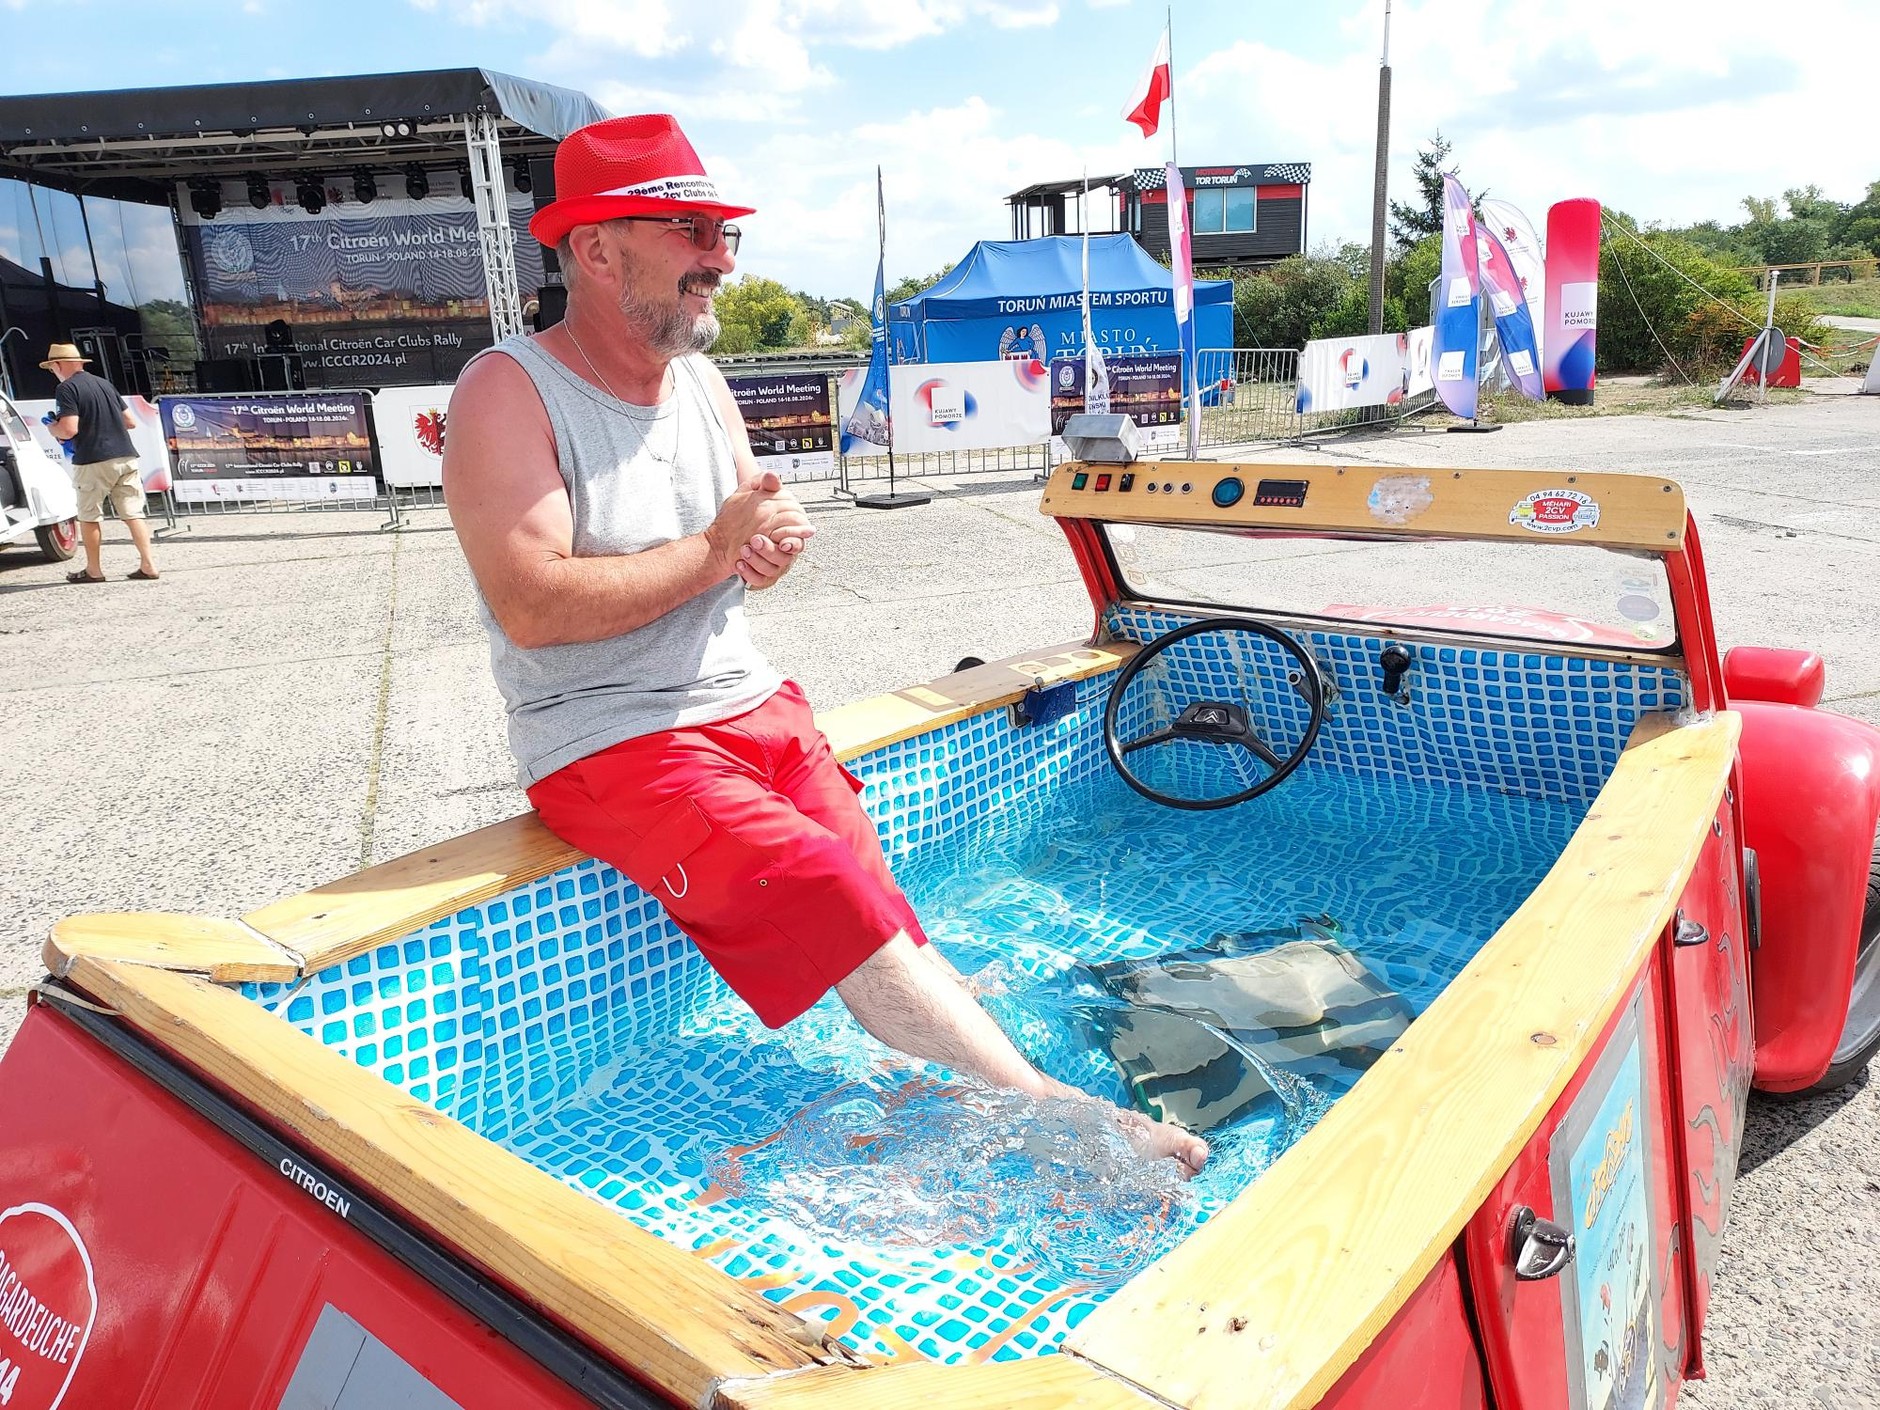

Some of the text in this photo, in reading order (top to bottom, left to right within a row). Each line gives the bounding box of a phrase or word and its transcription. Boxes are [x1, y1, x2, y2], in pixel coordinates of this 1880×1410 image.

[1195, 177, 1211, 185] TOR
[290, 231, 322, 251] 17th
[327, 231, 389, 250] Citroën
[393, 226, 444, 246] World
[387, 250, 426, 261] POLAND
[998, 295, 1046, 313] TORUŃ
[1115, 291, 1167, 306] SPORTU
[225, 342, 248, 355] 17th
[330, 337, 372, 351] Citroën
[375, 336, 396, 349] Car
[398, 333, 431, 347] Clubs
[434, 332, 463, 348] Rally
[758, 384, 785, 395] World
[786, 383, 821, 394] Meeting
[251, 405, 285, 415] Citroën
[286, 403, 315, 414] World
[317, 402, 356, 415] Meeting
[1529, 493, 1541, 502] 04
[1567, 491, 1578, 500] 72
[1526, 521, 1579, 533] www.2cvp.com
[279, 1158, 352, 1219] CITROEN
